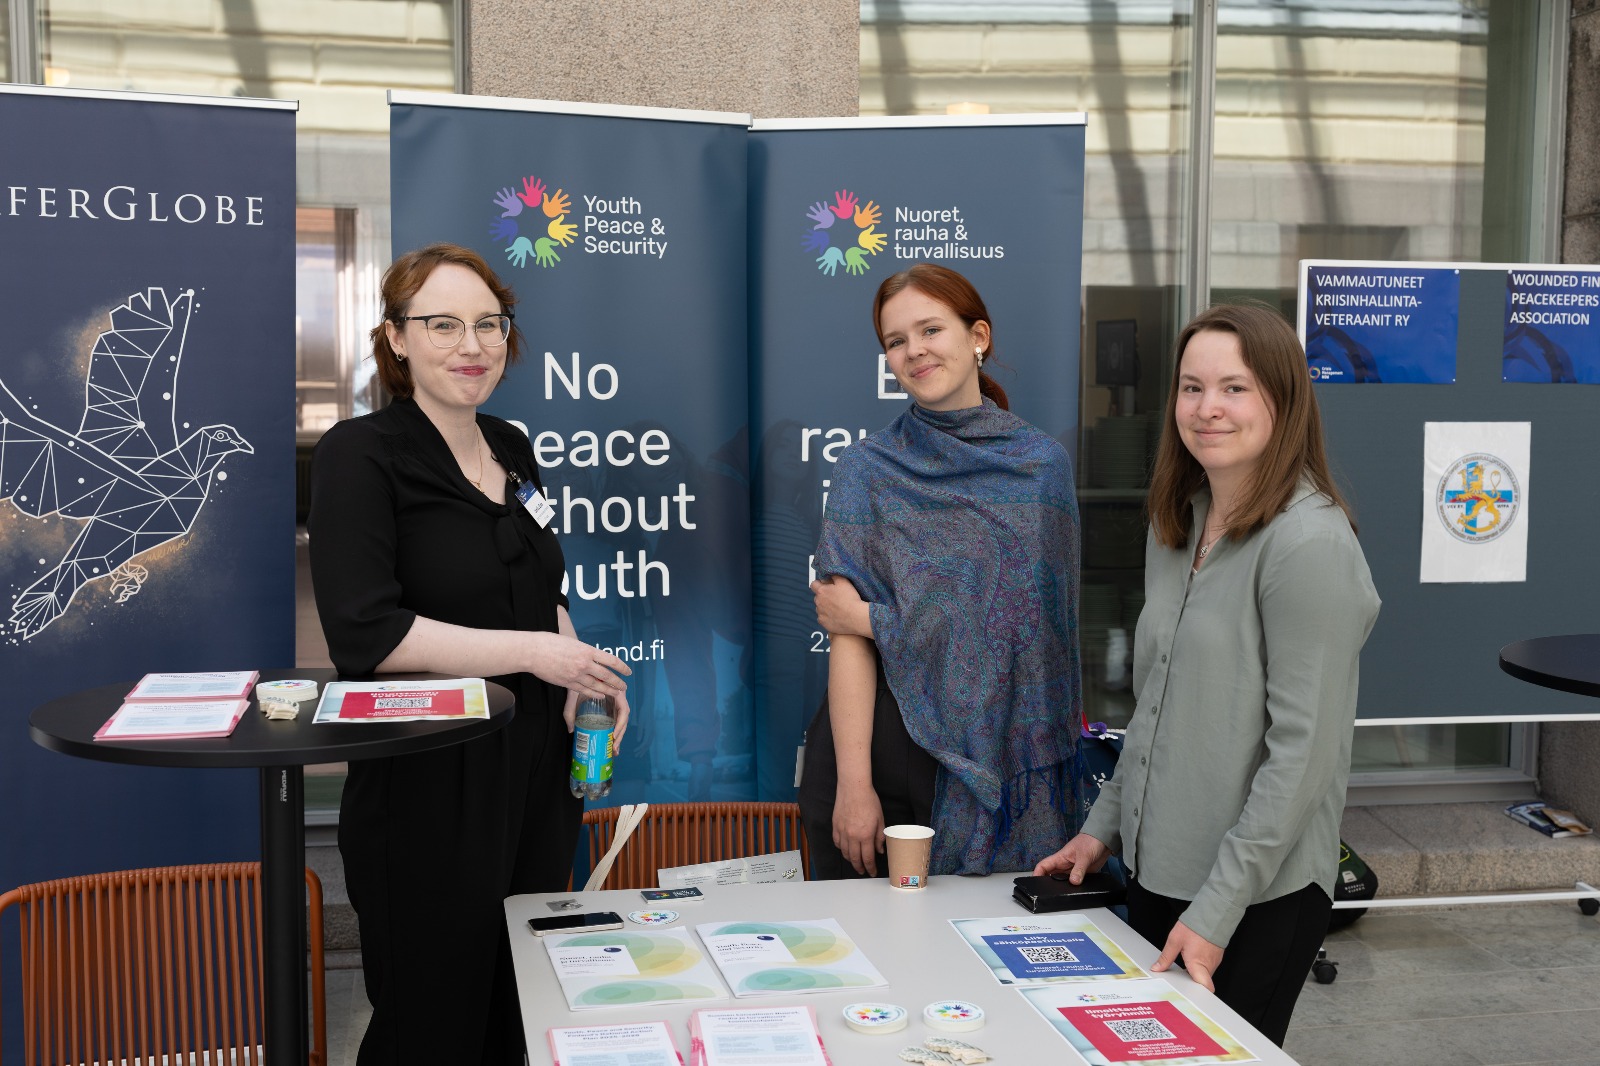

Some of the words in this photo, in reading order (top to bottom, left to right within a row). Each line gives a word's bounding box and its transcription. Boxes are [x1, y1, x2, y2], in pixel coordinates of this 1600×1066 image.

[0, 185, 265, 226] FERGLOBE
[583, 195, 642, 215] Youth
[895, 206, 965, 224] Nuoret,
[584, 215, 645, 235] Peace
[650, 217, 666, 236] &
[895, 225, 949, 241] rauha
[954, 225, 968, 241] &
[584, 235, 668, 260] Security
[894, 243, 1005, 259] turvallisuus
[1316, 274, 1425, 289] VAMMAUTUNEET
[1512, 273, 1578, 288] WOUNDED
[1315, 294, 1422, 308] KRIISINHALLINTA-
[1511, 293, 1599, 307] PEACEKEEPERS
[1315, 313, 1392, 327] VETERAANIT
[1394, 314, 1410, 328] RY
[1510, 312, 1591, 326] ASSOCIATION
[544, 351, 619, 401] No
[877, 353, 908, 400] E
[505, 420, 671, 469] eace
[543, 482, 697, 535] thout
[560, 549, 671, 600] uth
